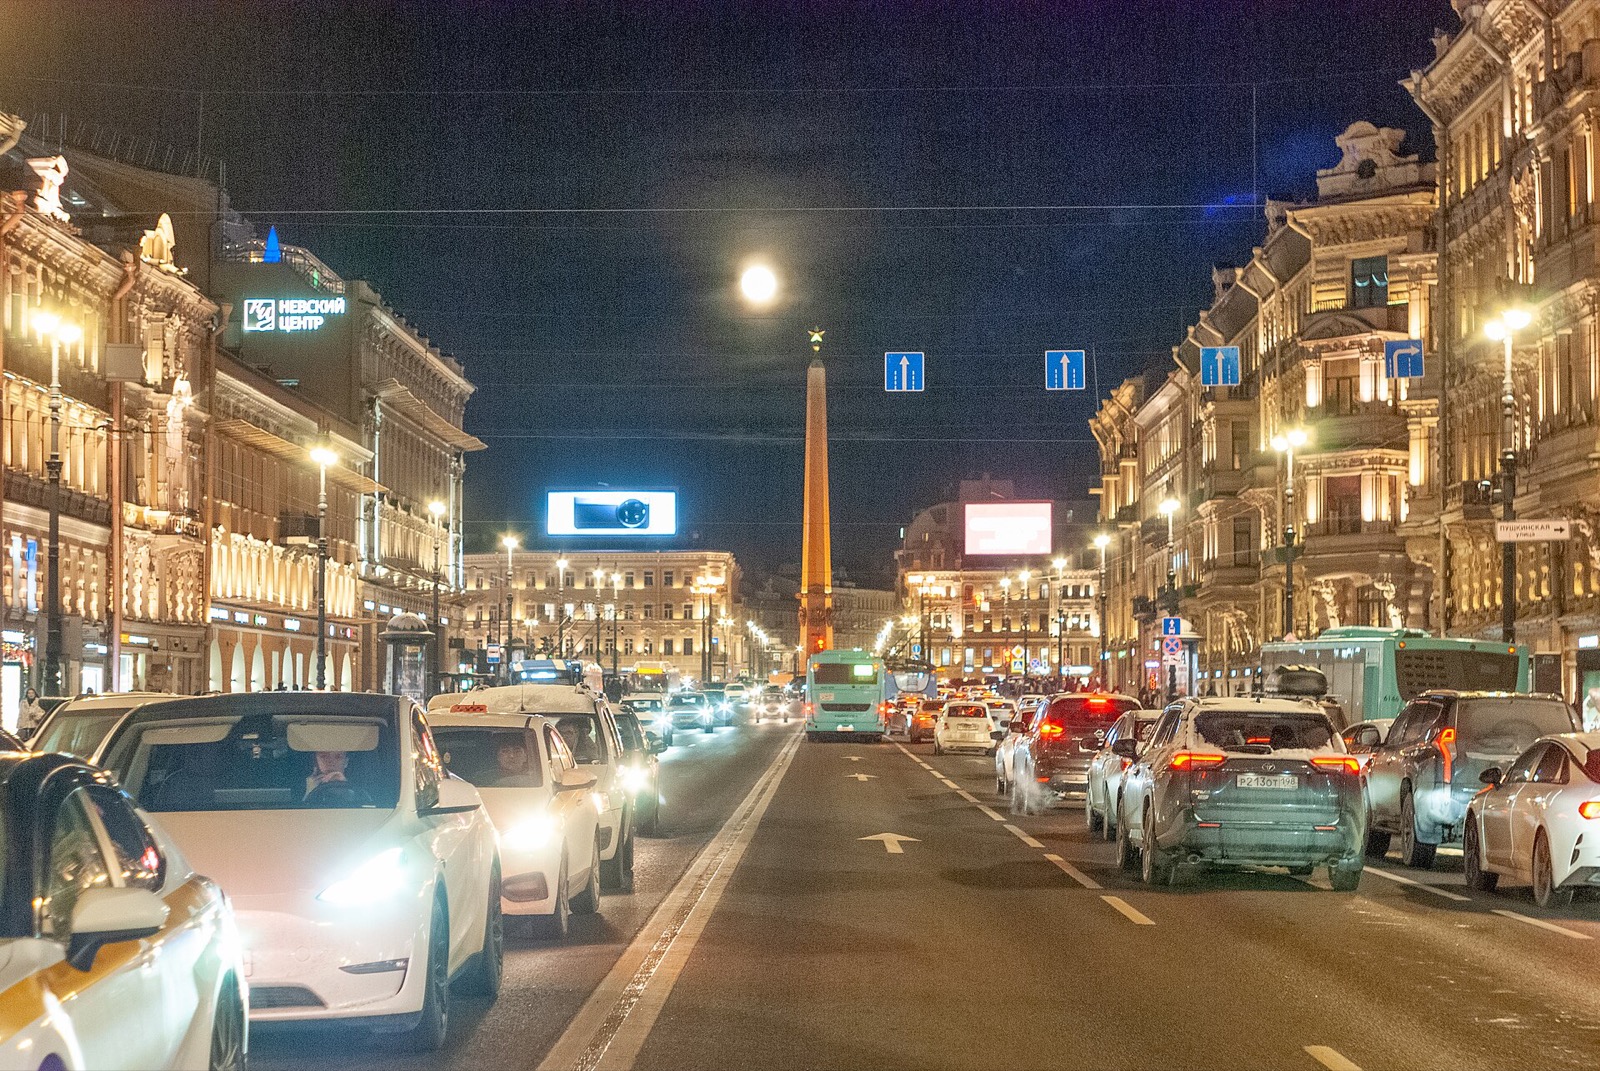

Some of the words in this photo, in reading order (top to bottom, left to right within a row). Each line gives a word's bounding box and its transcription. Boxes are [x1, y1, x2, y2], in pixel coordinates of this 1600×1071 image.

[278, 297, 346, 314] НЕВСКИЙ
[278, 316, 324, 333] ЦЕНТР
[1500, 524, 1551, 532] ПУШКИНСКАЯ
